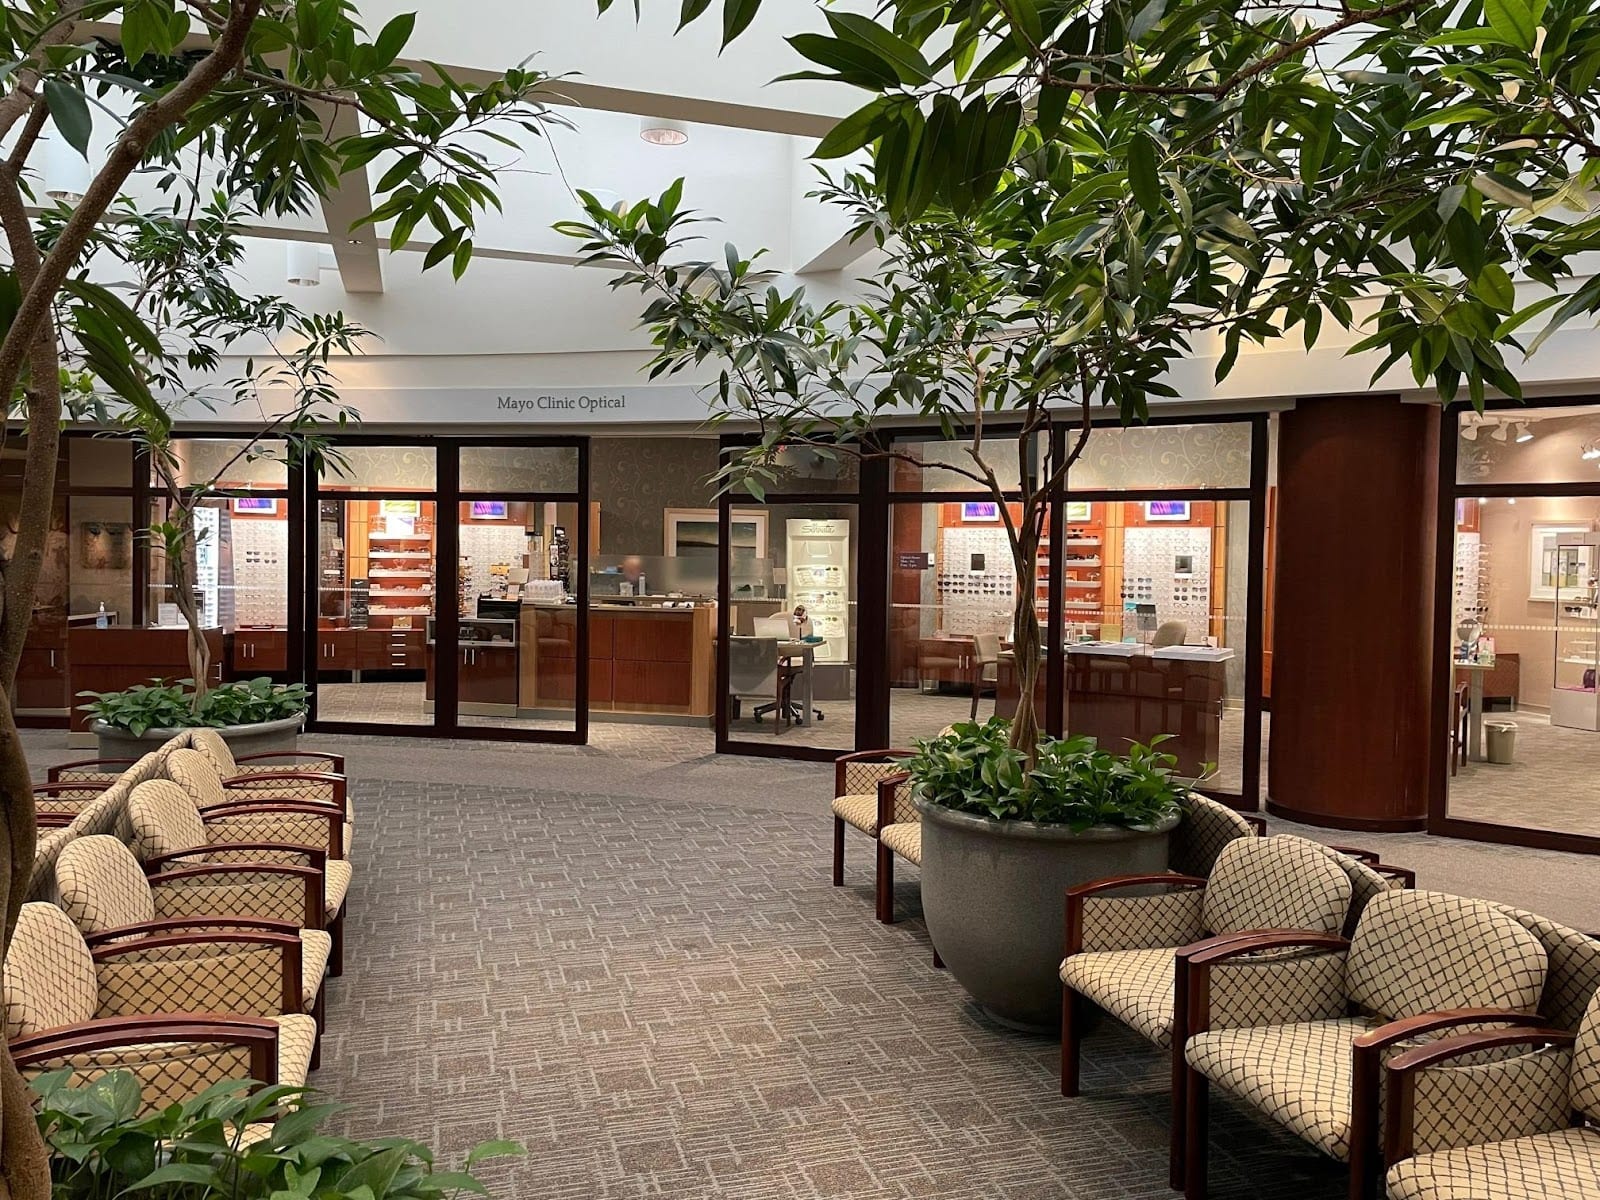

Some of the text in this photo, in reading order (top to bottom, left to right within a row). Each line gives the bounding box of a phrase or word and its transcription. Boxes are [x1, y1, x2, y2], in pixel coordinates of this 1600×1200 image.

[497, 395, 625, 413] Mayo Clinic Optical
